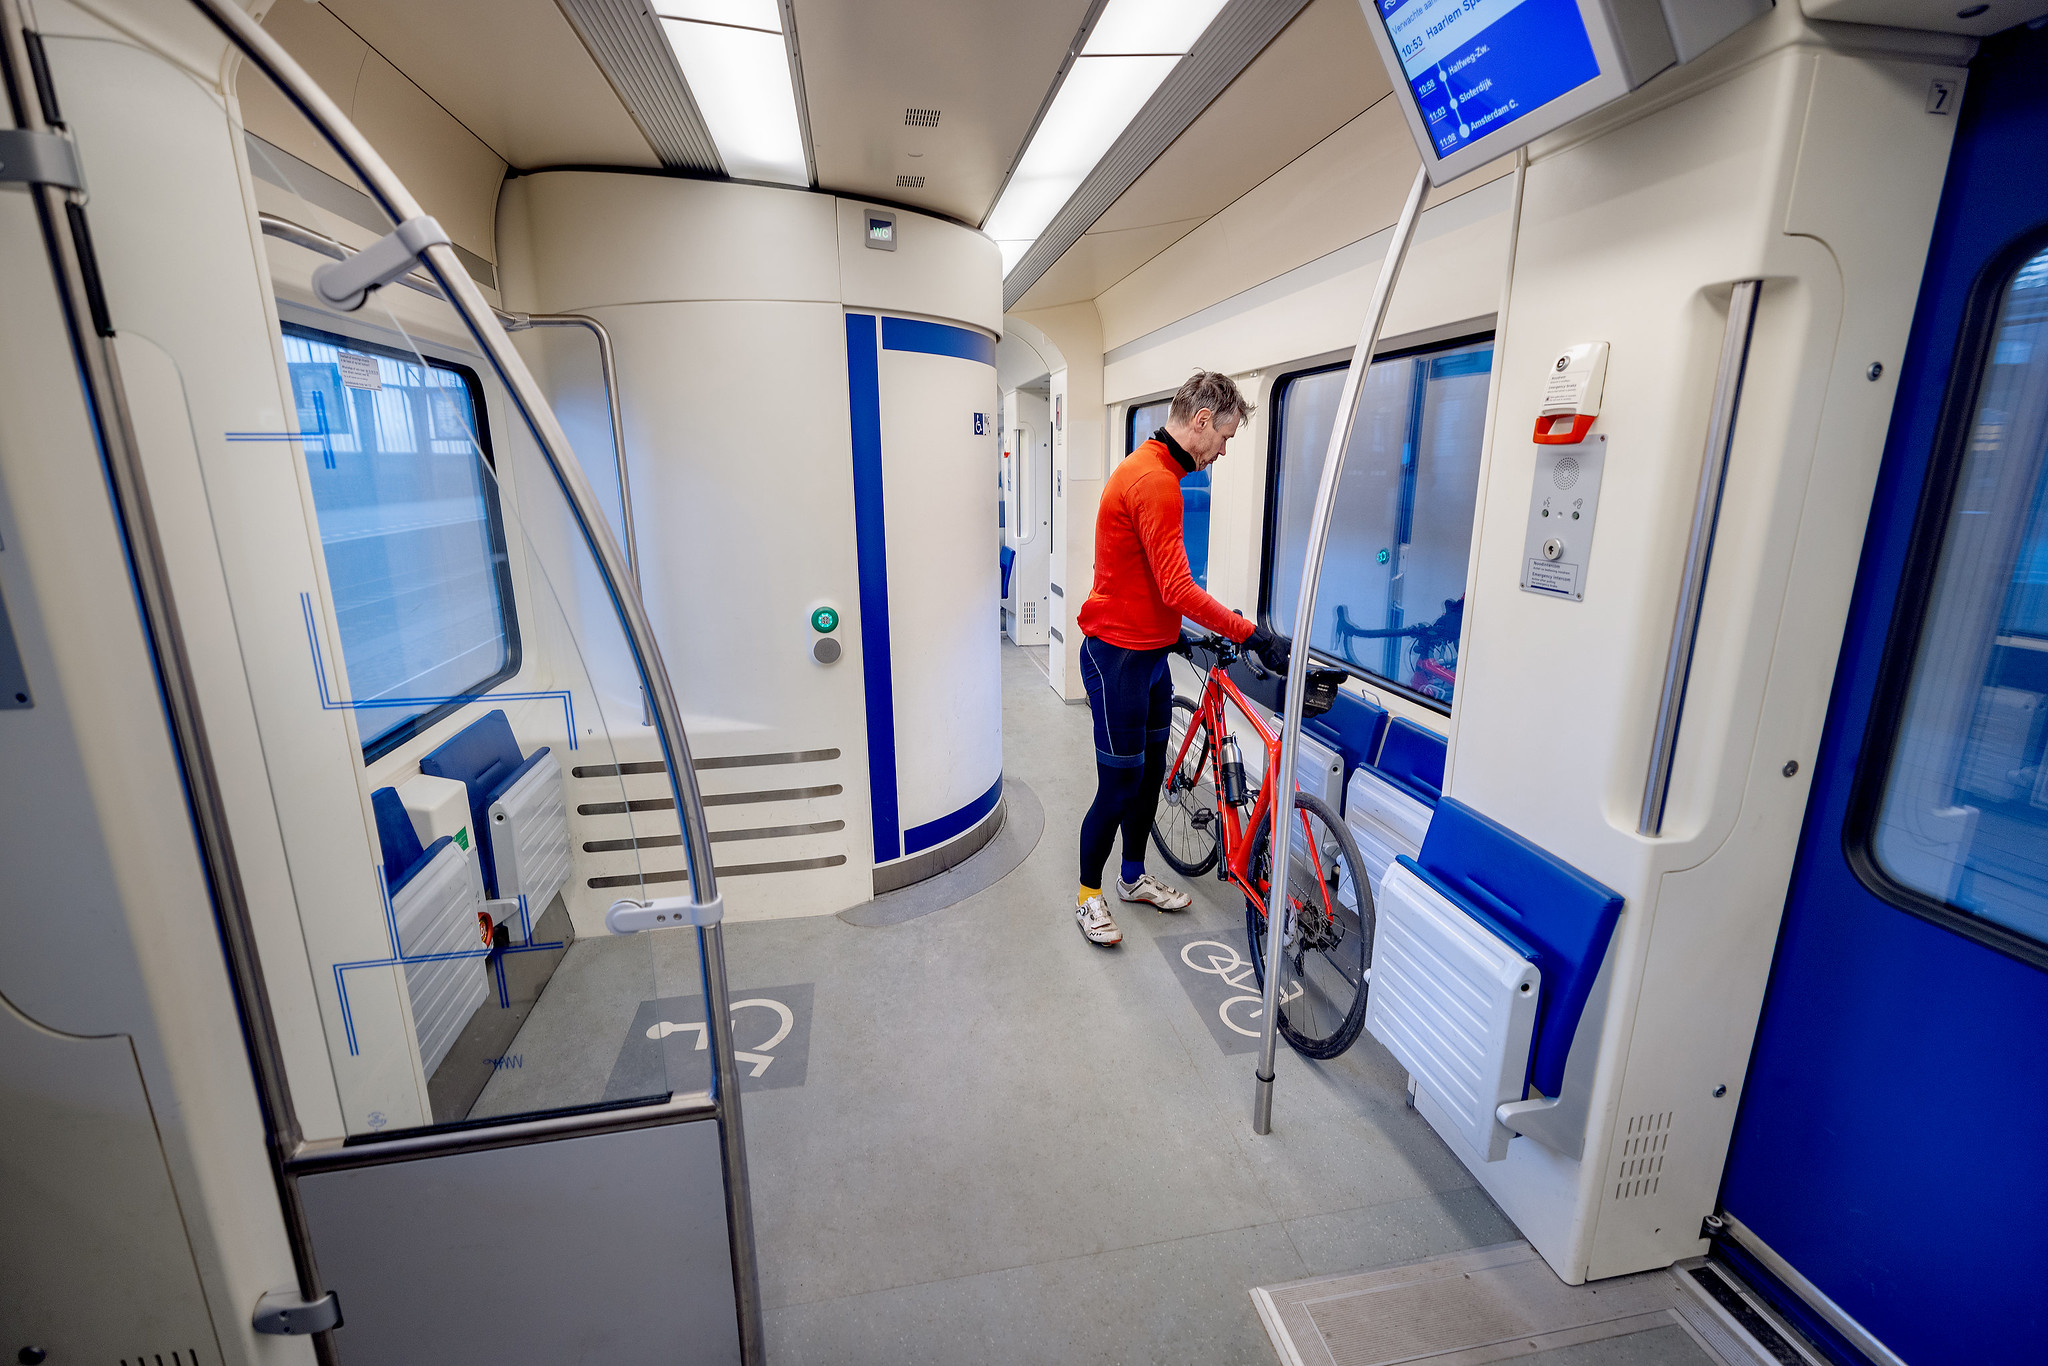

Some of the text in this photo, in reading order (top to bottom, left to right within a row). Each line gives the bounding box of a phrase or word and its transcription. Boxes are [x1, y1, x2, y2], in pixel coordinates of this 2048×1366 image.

[1391, 0, 1437, 35] Verwachte aa
[1401, 36, 1424, 57] 10:53
[1425, 8, 1462, 39] Haarlem
[1448, 45, 1490, 75] Halfweg-Zw.
[1418, 79, 1436, 95] 10:58
[1459, 78, 1493, 103] Sloterdijk
[1936, 89, 1948, 109] 7
[1429, 106, 1446, 121] 11:03
[1470, 99, 1519, 131] Amsterdam C.
[1440, 133, 1457, 147] 11:08
[873, 226, 889, 239] WC
[1207, 721, 1221, 802] TREK
